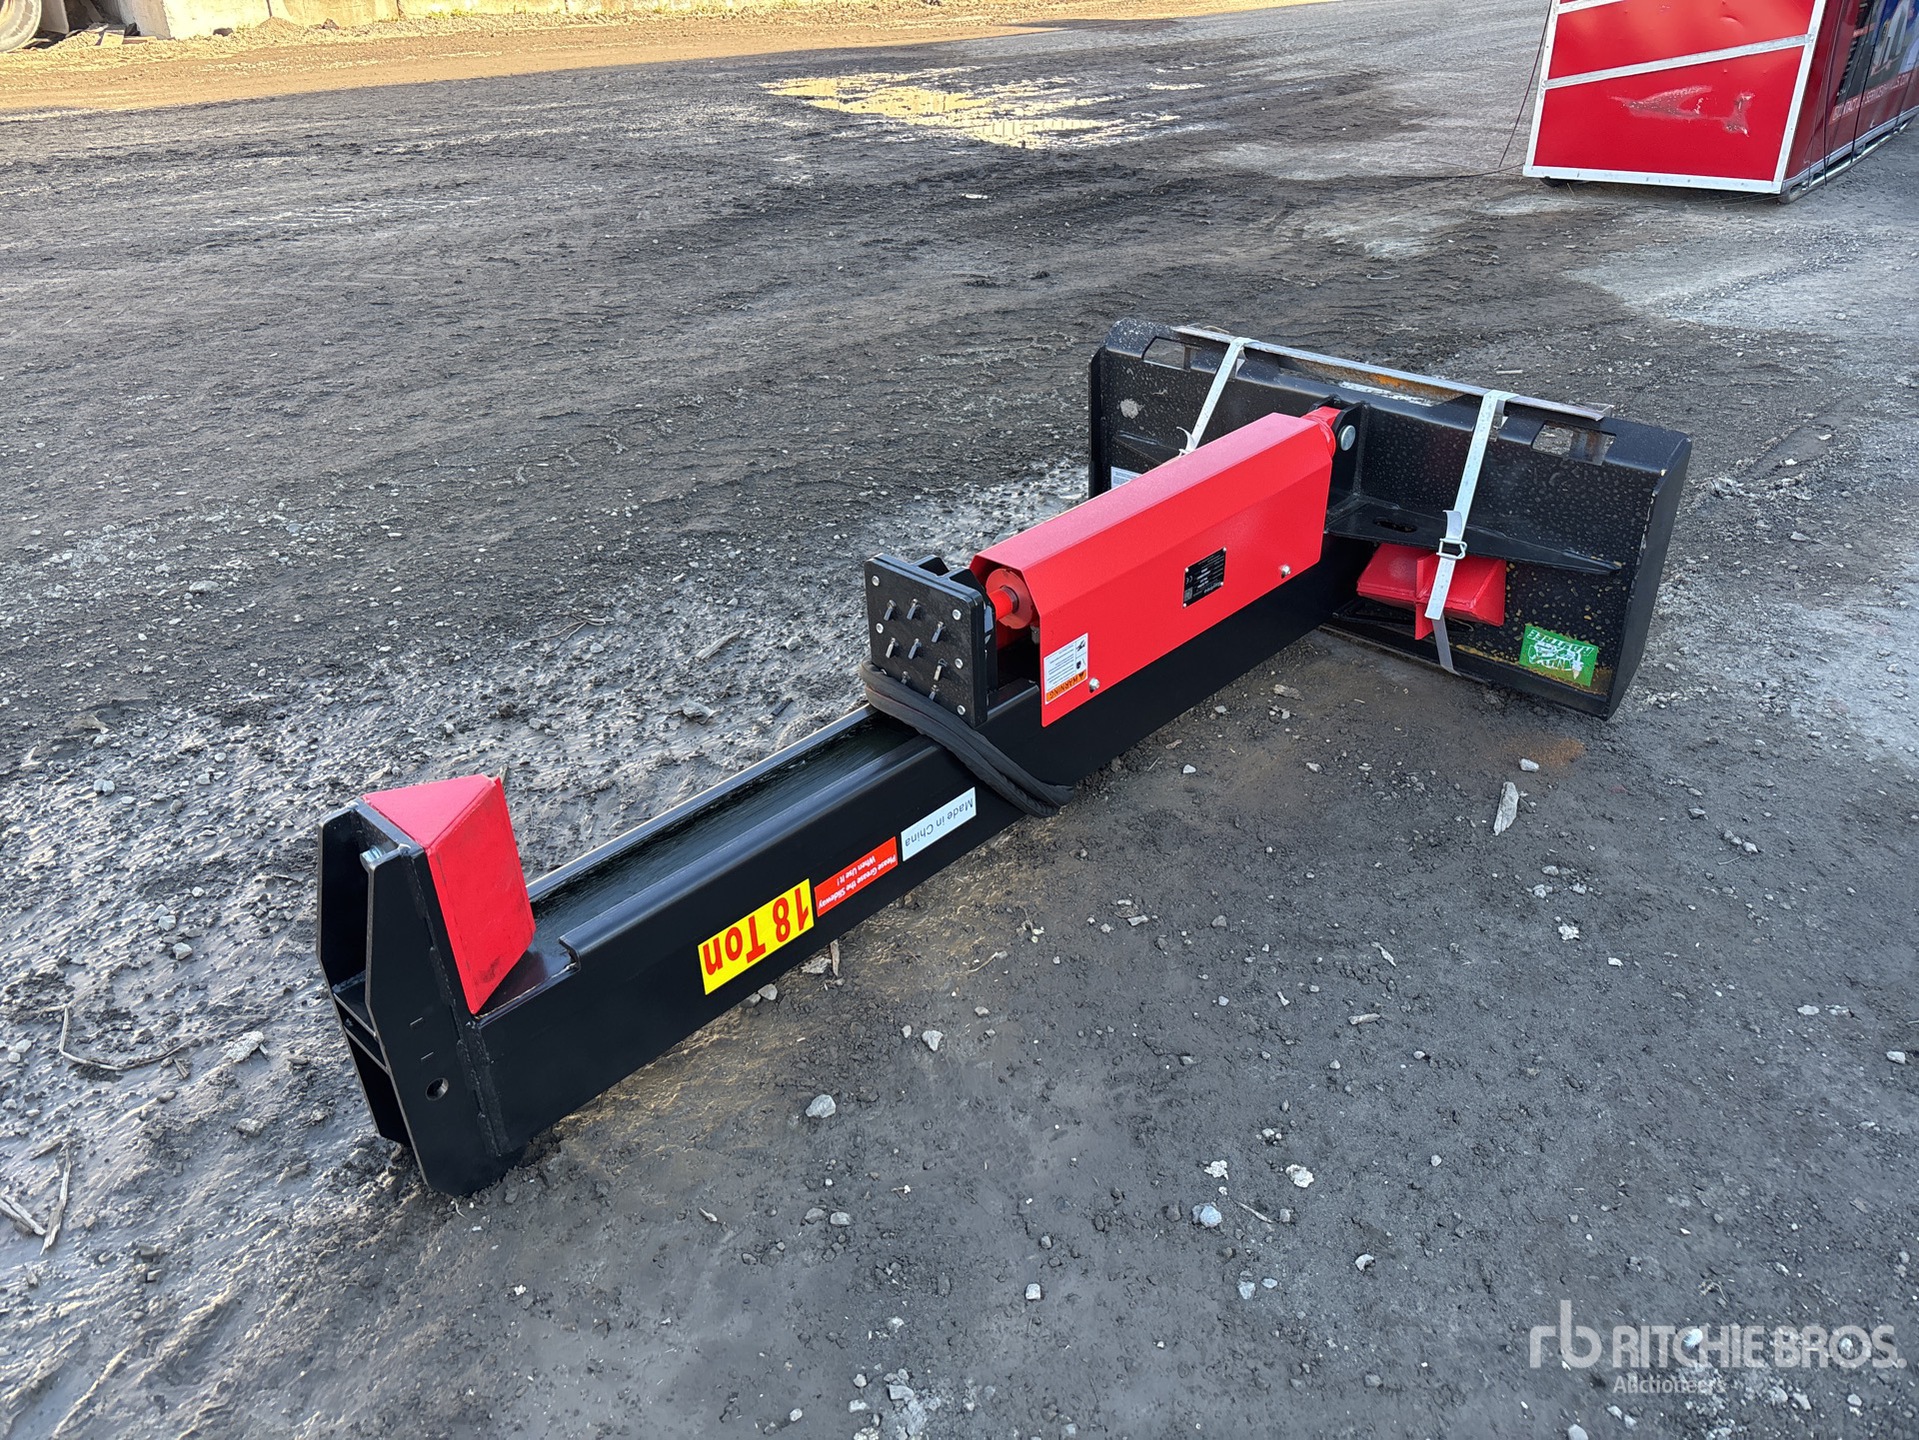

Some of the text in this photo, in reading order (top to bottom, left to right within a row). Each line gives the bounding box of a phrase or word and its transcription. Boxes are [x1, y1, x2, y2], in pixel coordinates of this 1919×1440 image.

[904, 798, 974, 848] Made in China
[818, 854, 896, 910] Please Grease the Slideway
[845, 862, 858, 877] Use
[858, 856, 876, 871] When
[702, 887, 809, 976] 18 Ton
